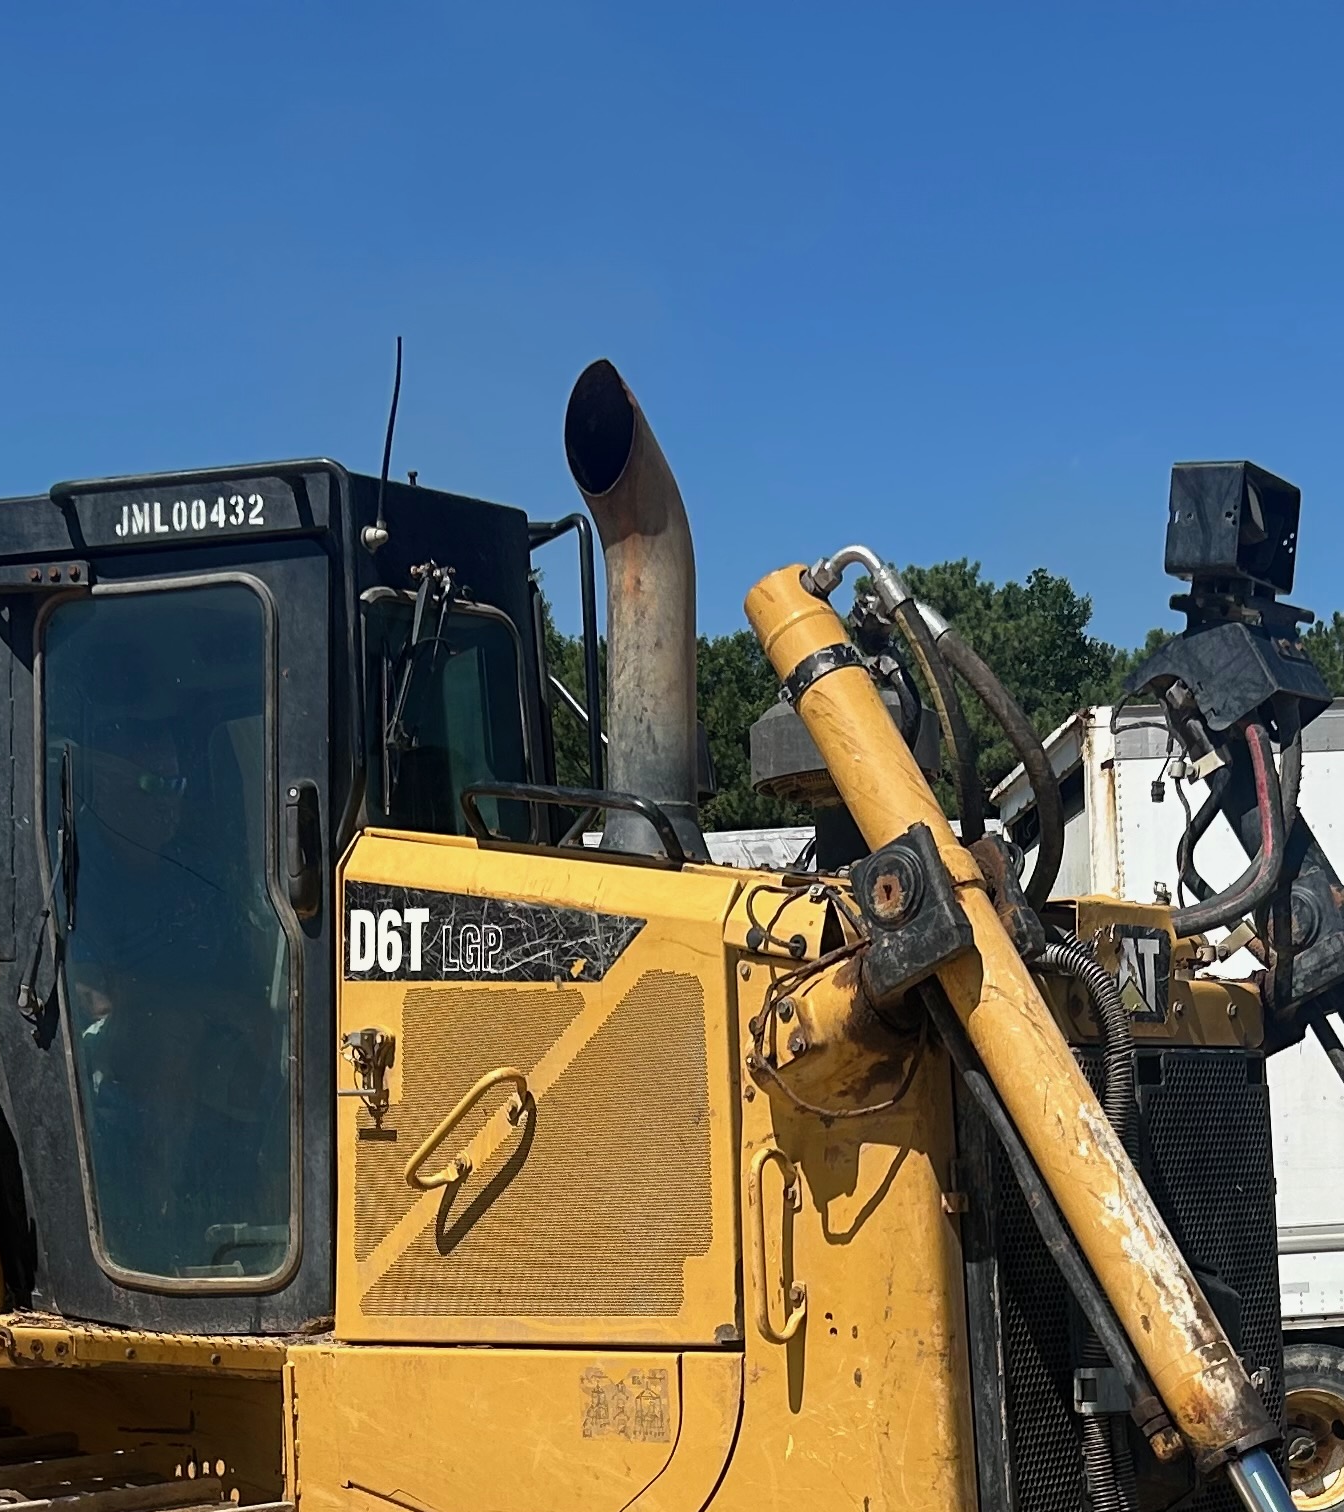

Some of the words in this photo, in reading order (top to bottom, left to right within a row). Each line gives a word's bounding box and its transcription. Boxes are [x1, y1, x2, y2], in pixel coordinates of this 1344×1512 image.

[115, 494, 264, 537] JML00432
[349, 908, 430, 973] D6T
[442, 924, 503, 973] LGP
[1118, 937, 1160, 1013] AT
